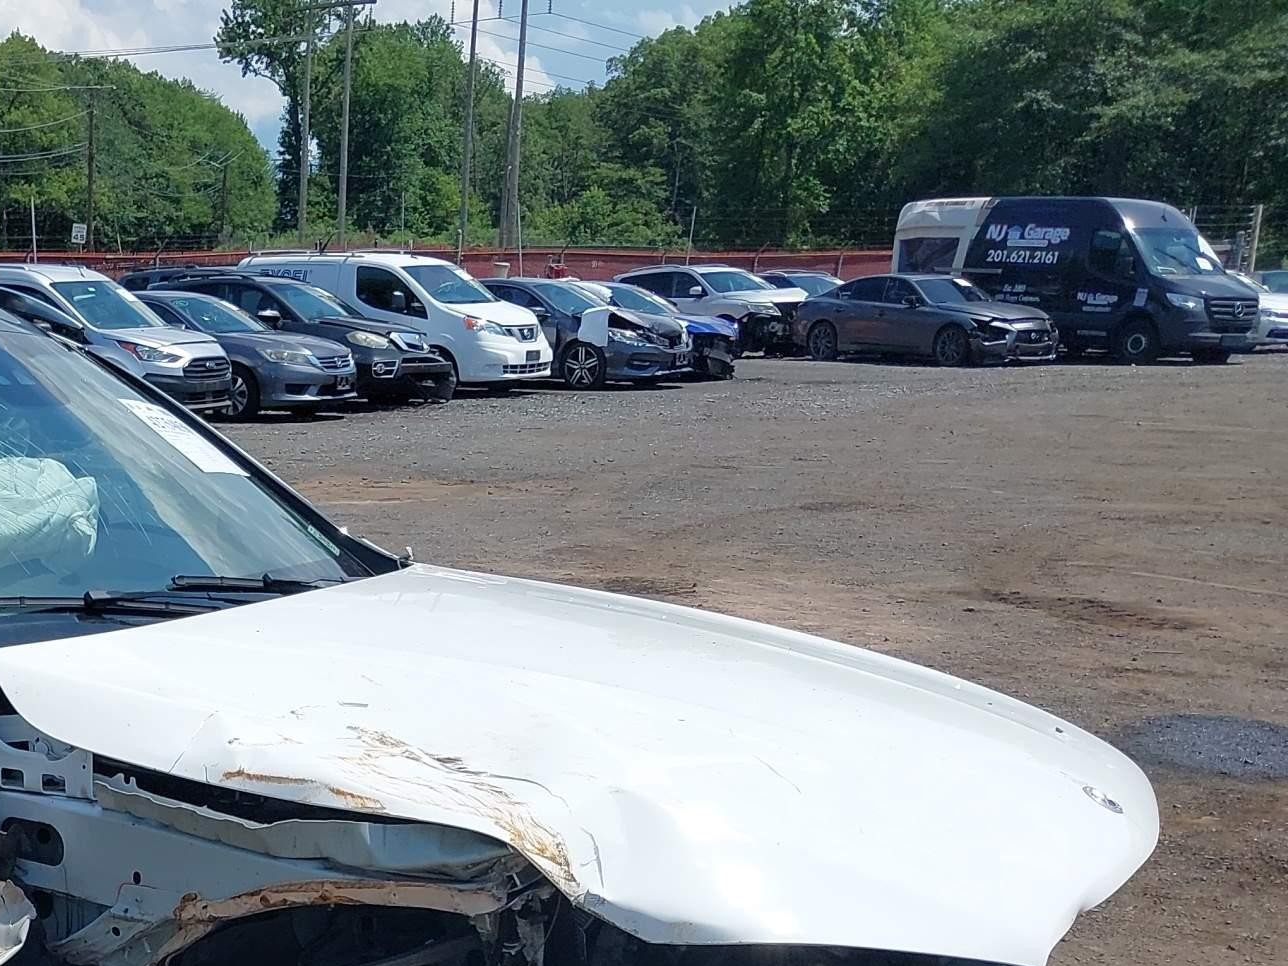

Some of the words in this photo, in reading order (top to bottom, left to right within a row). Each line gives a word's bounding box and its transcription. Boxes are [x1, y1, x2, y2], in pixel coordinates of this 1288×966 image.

[986, 224, 1009, 242] NJ
[1024, 224, 1070, 244] Garage
[986, 249, 1059, 263] 201.621.2161
